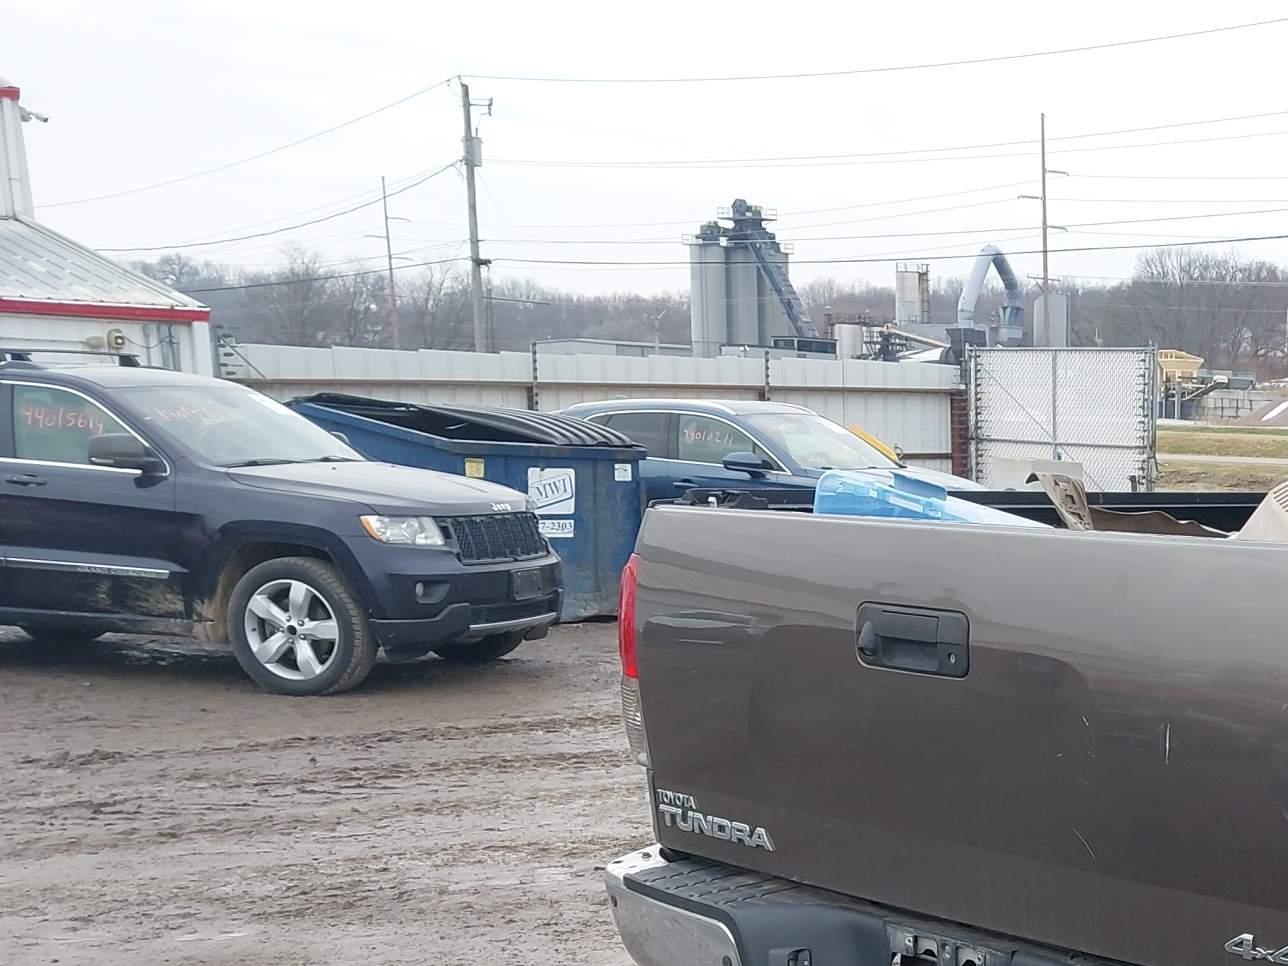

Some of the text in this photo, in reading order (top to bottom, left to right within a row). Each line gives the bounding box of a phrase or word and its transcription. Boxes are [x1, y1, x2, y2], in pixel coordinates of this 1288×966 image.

[535, 478, 568, 502] MWI
[656, 788, 697, 809] TOYOTA
[658, 803, 777, 852] TUNDRA
